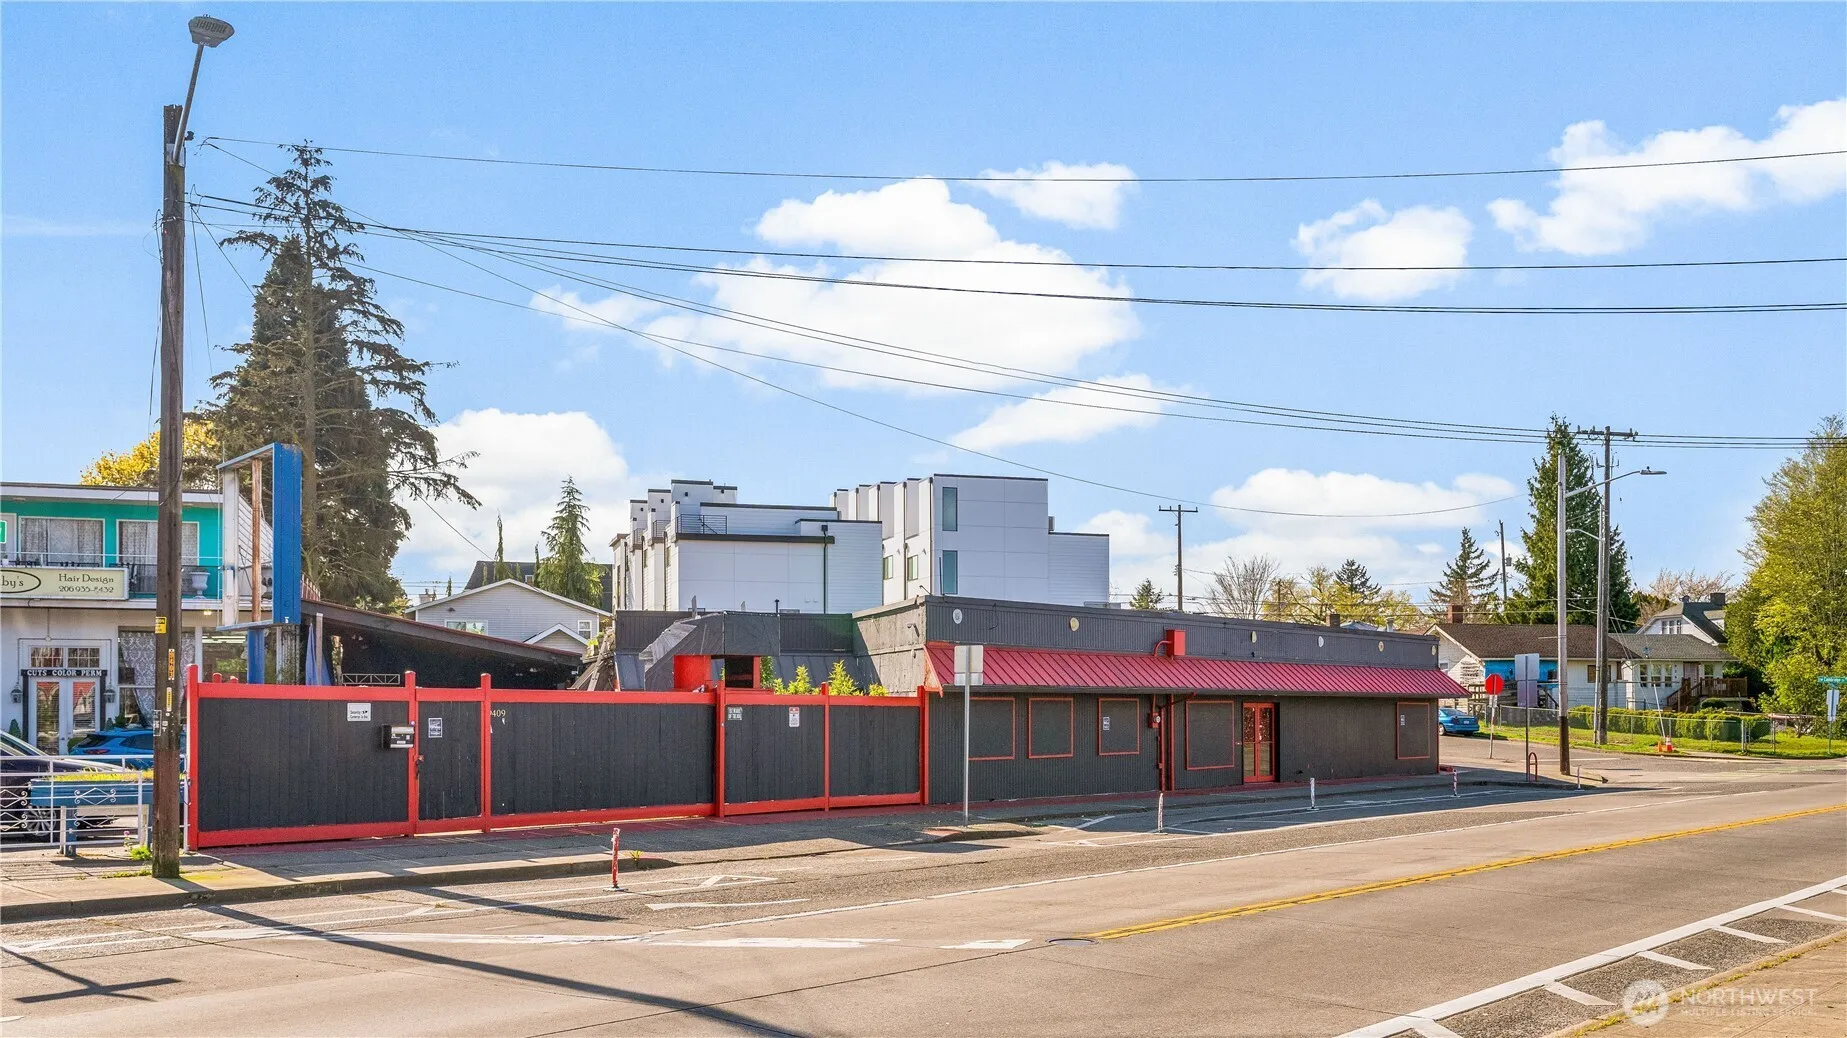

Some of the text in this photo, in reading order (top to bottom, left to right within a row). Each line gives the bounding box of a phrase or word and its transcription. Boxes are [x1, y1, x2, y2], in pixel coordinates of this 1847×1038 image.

[58, 573, 114, 585] Hair Design
[58, 585, 75, 593] 206
[27, 669, 102, 677] CUTS COLOR PERM
[490, 709, 506, 718] 409
